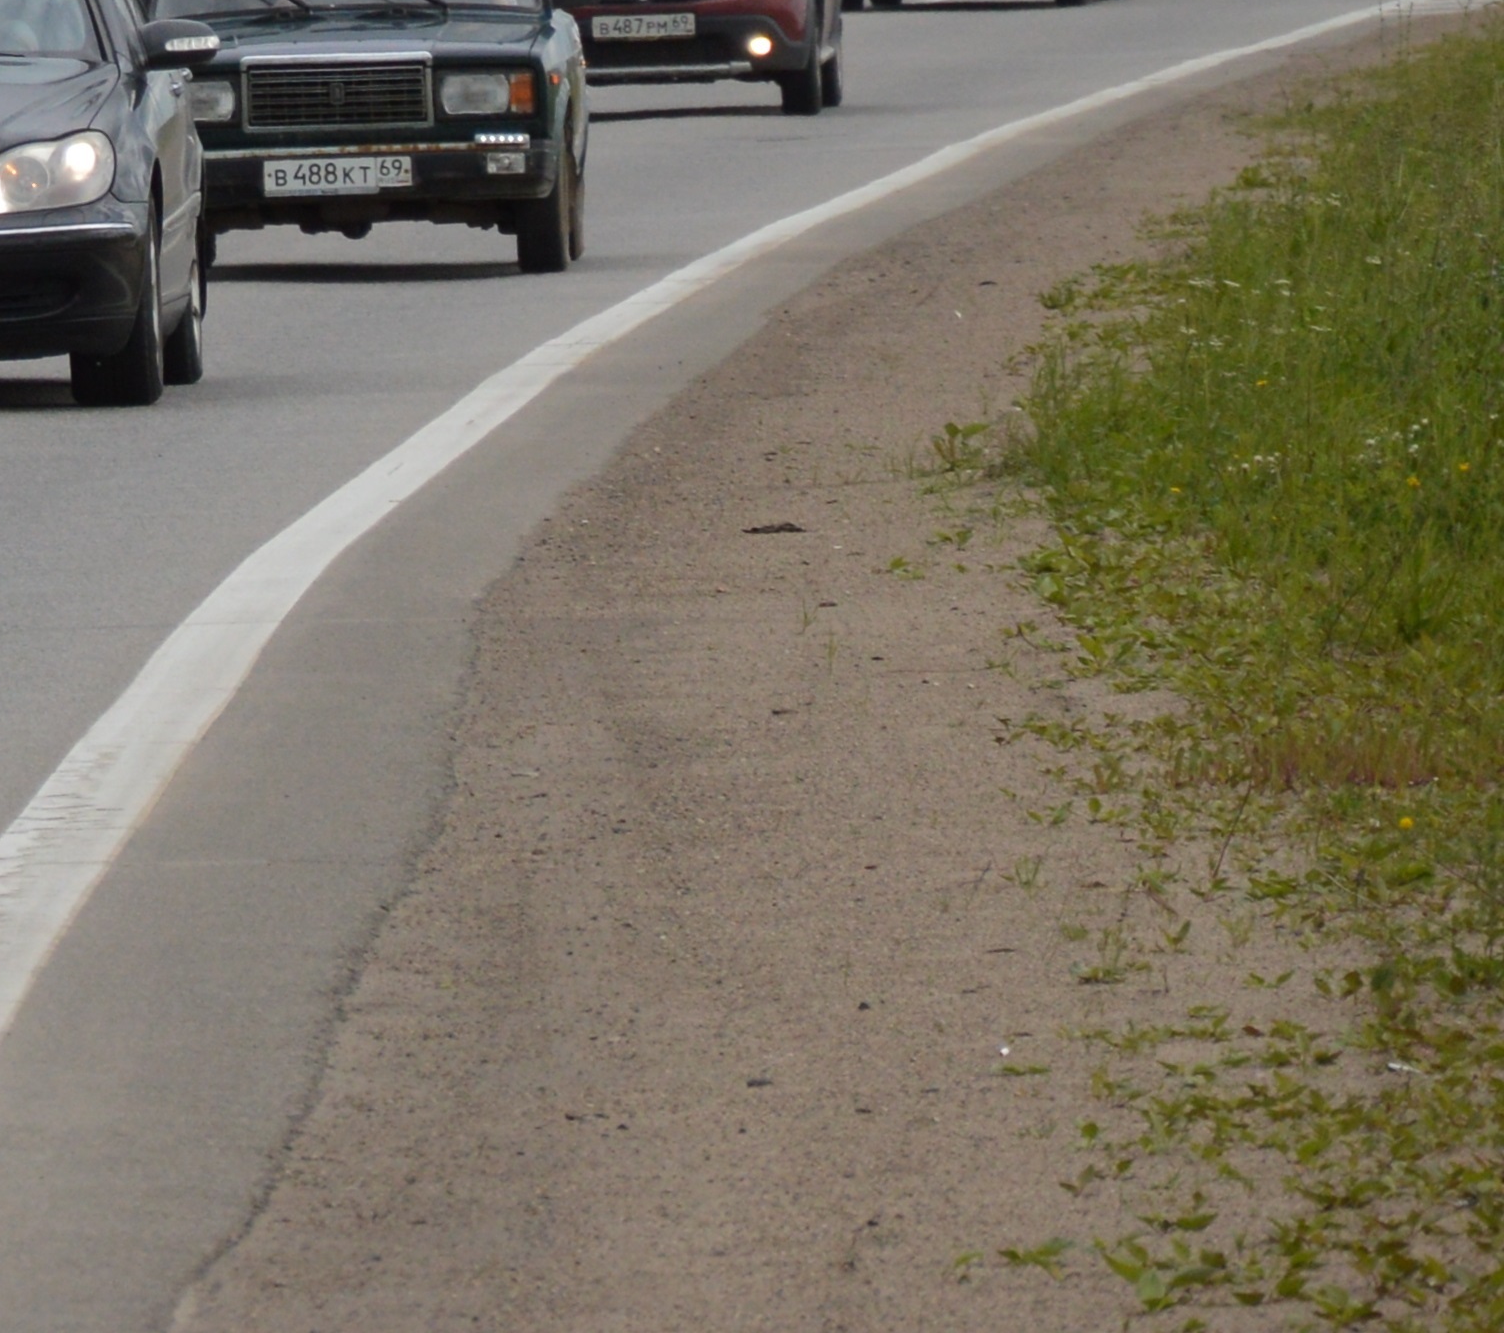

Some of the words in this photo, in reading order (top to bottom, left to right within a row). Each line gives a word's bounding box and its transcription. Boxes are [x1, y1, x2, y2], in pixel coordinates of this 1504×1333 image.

[600, 18, 667, 35] В487РМ
[672, 15, 688, 30] 69
[274, 162, 371, 186] В488КТ
[379, 159, 403, 176] 69
